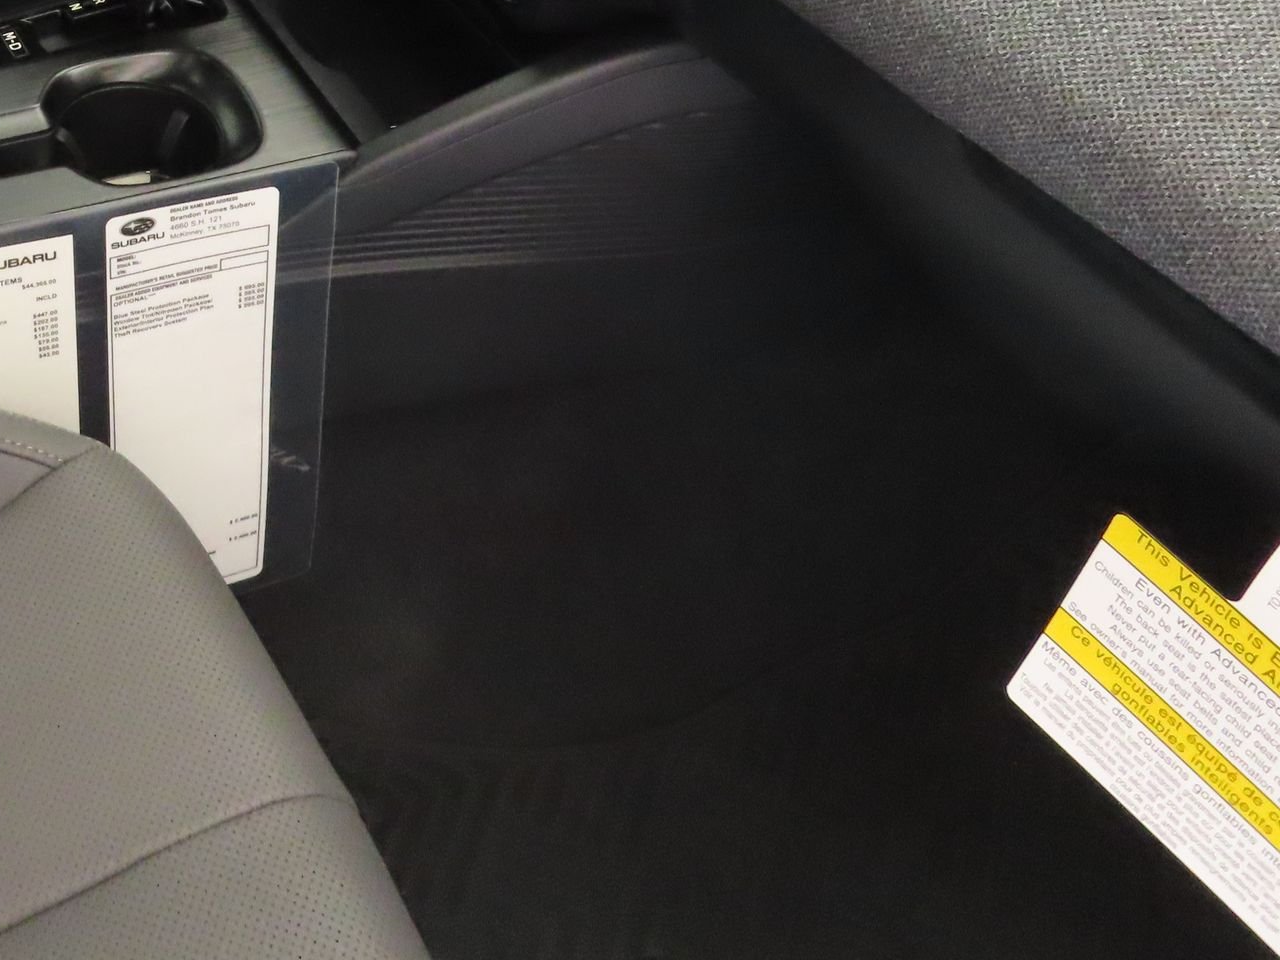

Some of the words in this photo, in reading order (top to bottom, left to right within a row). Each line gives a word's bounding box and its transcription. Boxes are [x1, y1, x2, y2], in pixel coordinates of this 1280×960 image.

[69, 2, 83, 11] N
[111, 231, 164, 249] SUBARU
[170, 210, 200, 222] Brandon
[203, 205, 227, 215] Tomes
[229, 200, 255, 210] Subaru
[209, 215, 221, 223] 121
[113, 315, 139, 325] Window
[148, 299, 180, 312] Protection
[182, 293, 208, 304] Package
[165, 307, 197, 320] Protection
[200, 303, 214, 311] Plan
[1135, 532, 1170, 567] This
[1176, 568, 1240, 629] Vehicle
[1246, 630, 1265, 651] is
[1135, 578, 1171, 613] Even
[1176, 615, 1205, 645] with
[1170, 582, 1256, 664] Advanced
[1068, 601, 1087, 621] See
[1091, 622, 1127, 657] owner's
[1131, 659, 1166, 693] manual
[1168, 692, 1185, 710] for
[1094, 560, 1134, 599] Children
[1135, 598, 1155, 619] can
[1156, 616, 1173, 635] be
[1174, 632, 1201, 660] killed
[1202, 659, 1216, 674] or
[1217, 672, 1264, 718] seriously
[1107, 605, 1135, 633] Never
[1137, 633, 1156, 653] put
[1168, 660, 1222, 713] rear-facing
[1225, 711, 1251, 738] child
[1109, 623, 1144, 658] Always
[1146, 657, 1165, 677] use
[1113, 593, 1133, 615] The
[1135, 613, 1160, 639] back
[1199, 671, 1217, 691] the
[1042, 641, 1077, 676] Même
[1081, 677, 1107, 705] avec
[1111, 705, 1134, 729] des
[1137, 729, 1189, 780] coussins
[1192, 782, 1257, 845] gonflables
[1069, 624, 1091, 648] Ce
[1095, 648, 1154, 705] véhicule
[1157, 706, 1181, 731] est
[1186, 731, 1238, 784] équipé
[1242, 784, 1264, 808] de
[1111, 683, 1185, 753] gonflables
[1189, 754, 1274, 837] intelligents
